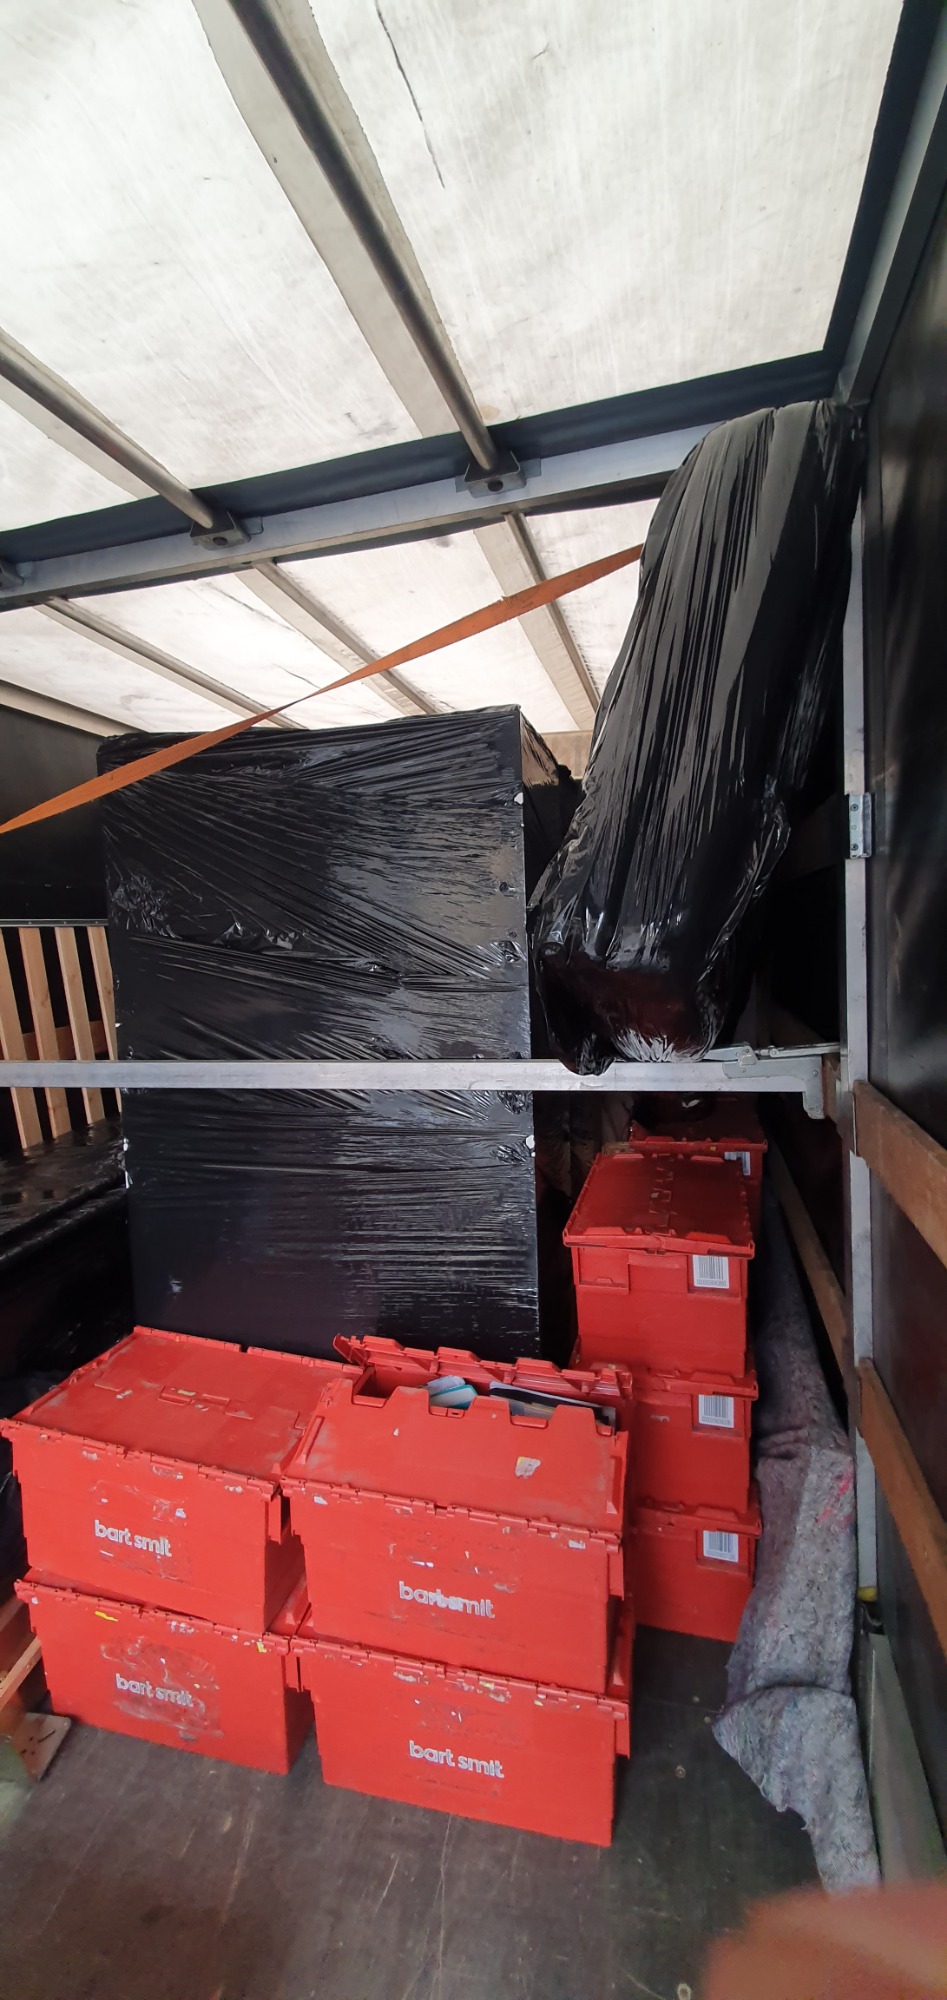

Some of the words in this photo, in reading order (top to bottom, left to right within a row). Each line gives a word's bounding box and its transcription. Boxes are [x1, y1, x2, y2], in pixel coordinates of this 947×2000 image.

[94, 1519, 133, 1546] bart
[133, 1534, 173, 1557] smit
[398, 1580, 448, 1609] bart
[115, 1672, 154, 1699] bart
[155, 1686, 194, 1708] smit
[408, 1739, 456, 1767] bart
[457, 1755, 505, 1778] smit
